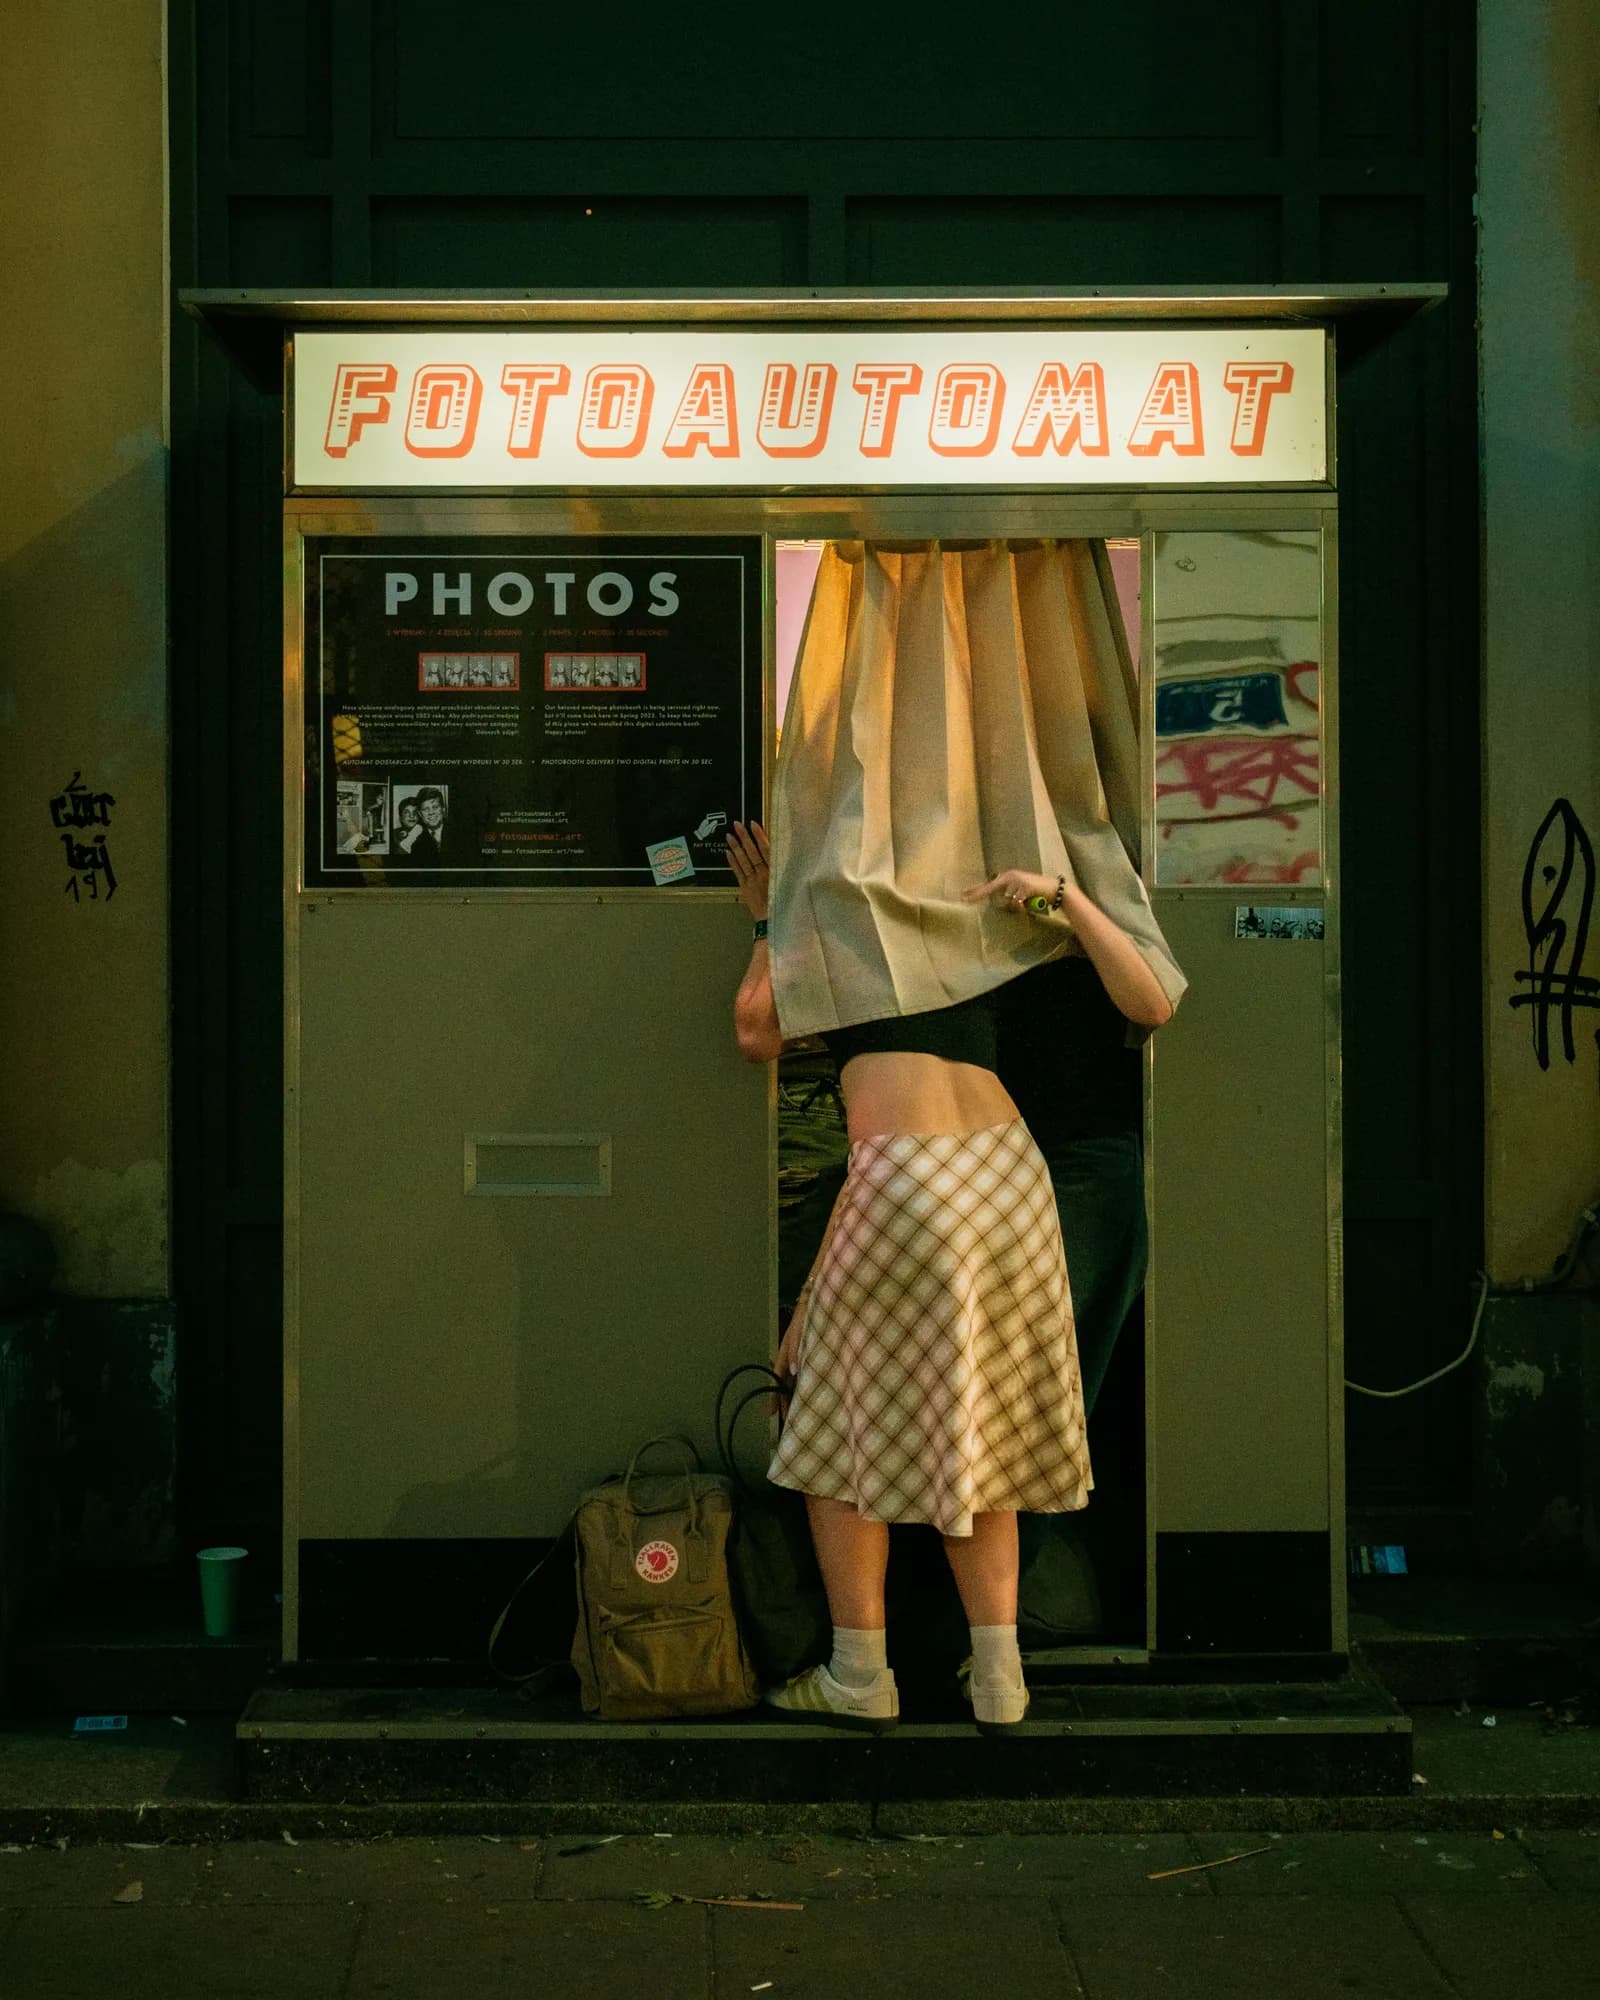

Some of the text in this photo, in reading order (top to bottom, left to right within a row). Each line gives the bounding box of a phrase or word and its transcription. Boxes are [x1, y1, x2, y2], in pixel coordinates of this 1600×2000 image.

[324, 362, 1295, 459] FOTOAUTOMAT
[385, 572, 680, 617] PHOTOS
[544, 704, 556, 712] Our
[558, 704, 580, 712] beloved
[610, 704, 641, 712] photobooth
[643, 704, 648, 712] is
[650, 704, 665, 712] being
[692, 704, 705, 712] right
[449, 712, 460, 720] Aby
[567, 712, 582, 720] come
[583, 712, 597, 720] back
[599, 712, 611, 720] here
[613, 712, 619, 720] in
[659, 712, 666, 720] To
[667, 712, 681, 720] keep
[682, 712, 692, 720] the
[693, 712, 718, 720] tradition
[544, 720, 551, 728] of
[552, 720, 562, 728] this
[624, 720, 635, 728] this
[636, 720, 654, 728] digital
[544, 729, 563, 737] Happy
